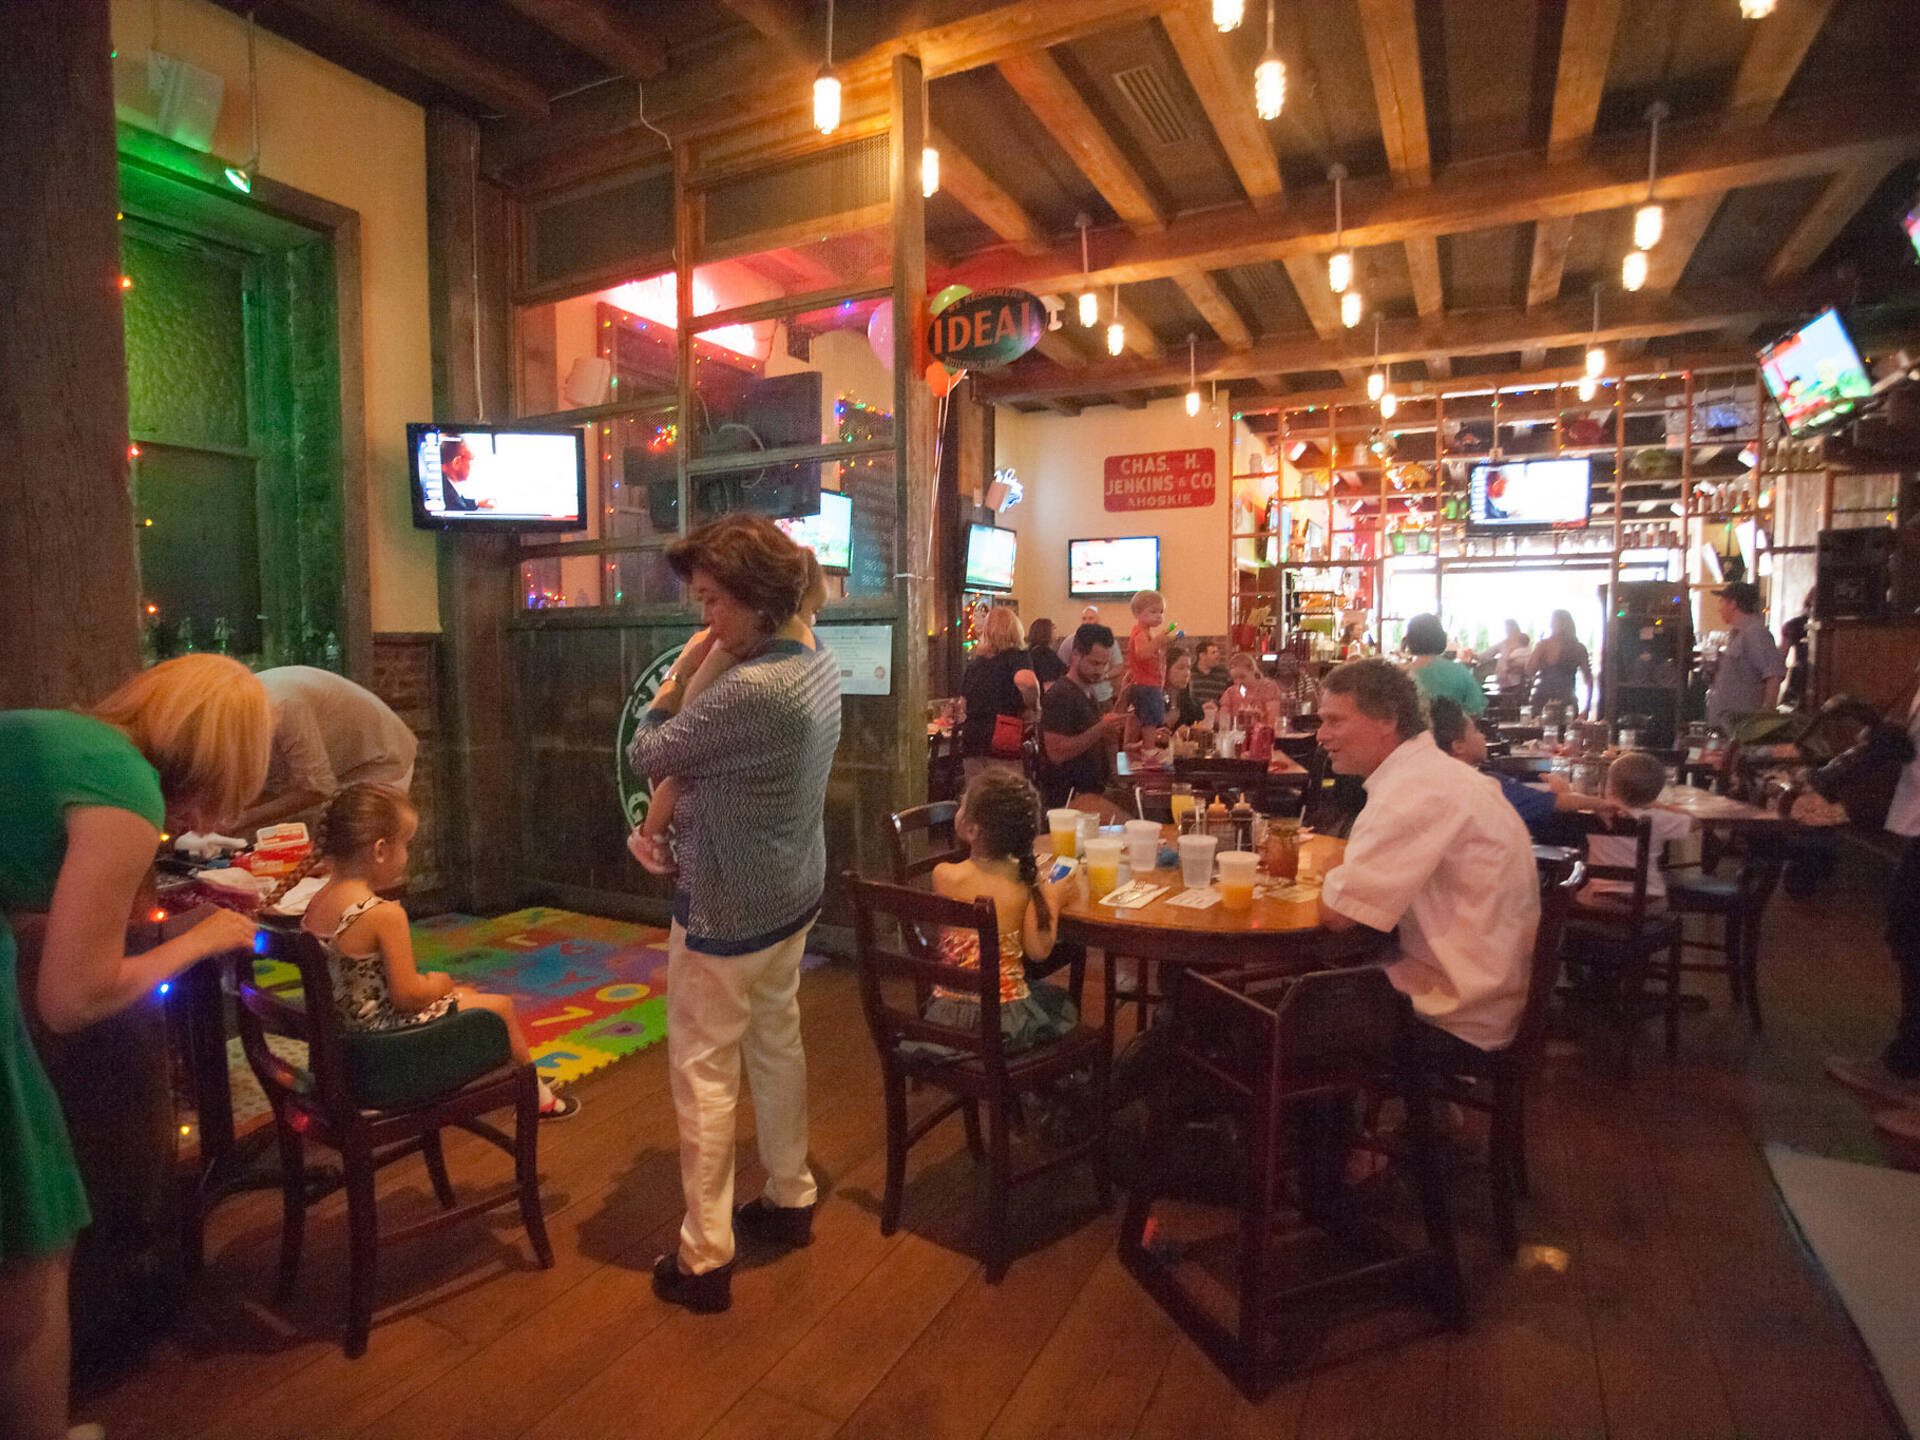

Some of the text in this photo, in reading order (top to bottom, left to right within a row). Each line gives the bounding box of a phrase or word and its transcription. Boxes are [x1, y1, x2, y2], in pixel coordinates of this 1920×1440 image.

[1120, 455, 1171, 475] CHAS.
[1105, 474, 1174, 497] JENKINS
[1190, 471, 1216, 490] CO.
[1128, 492, 1192, 507] AHOSKIE
